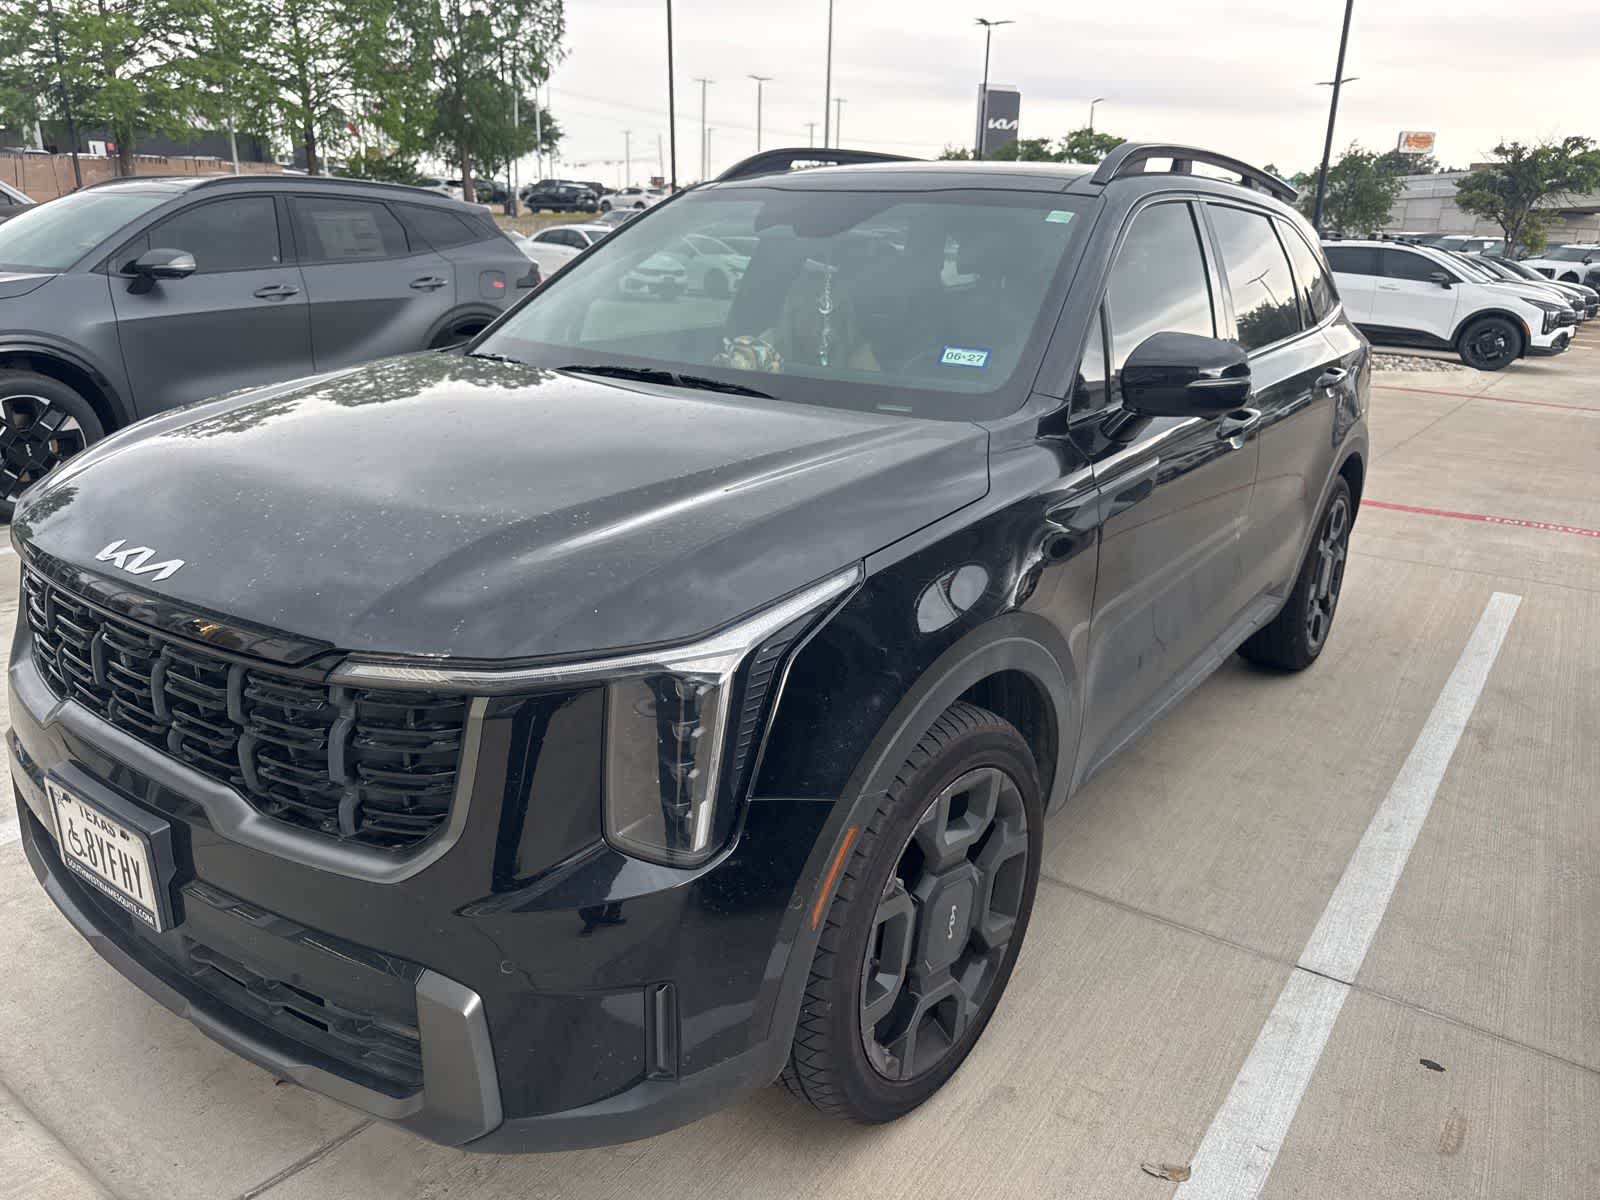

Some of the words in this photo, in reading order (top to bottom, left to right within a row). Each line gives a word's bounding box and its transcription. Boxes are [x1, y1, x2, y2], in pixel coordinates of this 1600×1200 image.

[988, 117, 1018, 130] KIA
[95, 539, 185, 582] KIA
[78, 805, 116, 839] TEXAS
[84, 828, 144, 900] 8YFHY
